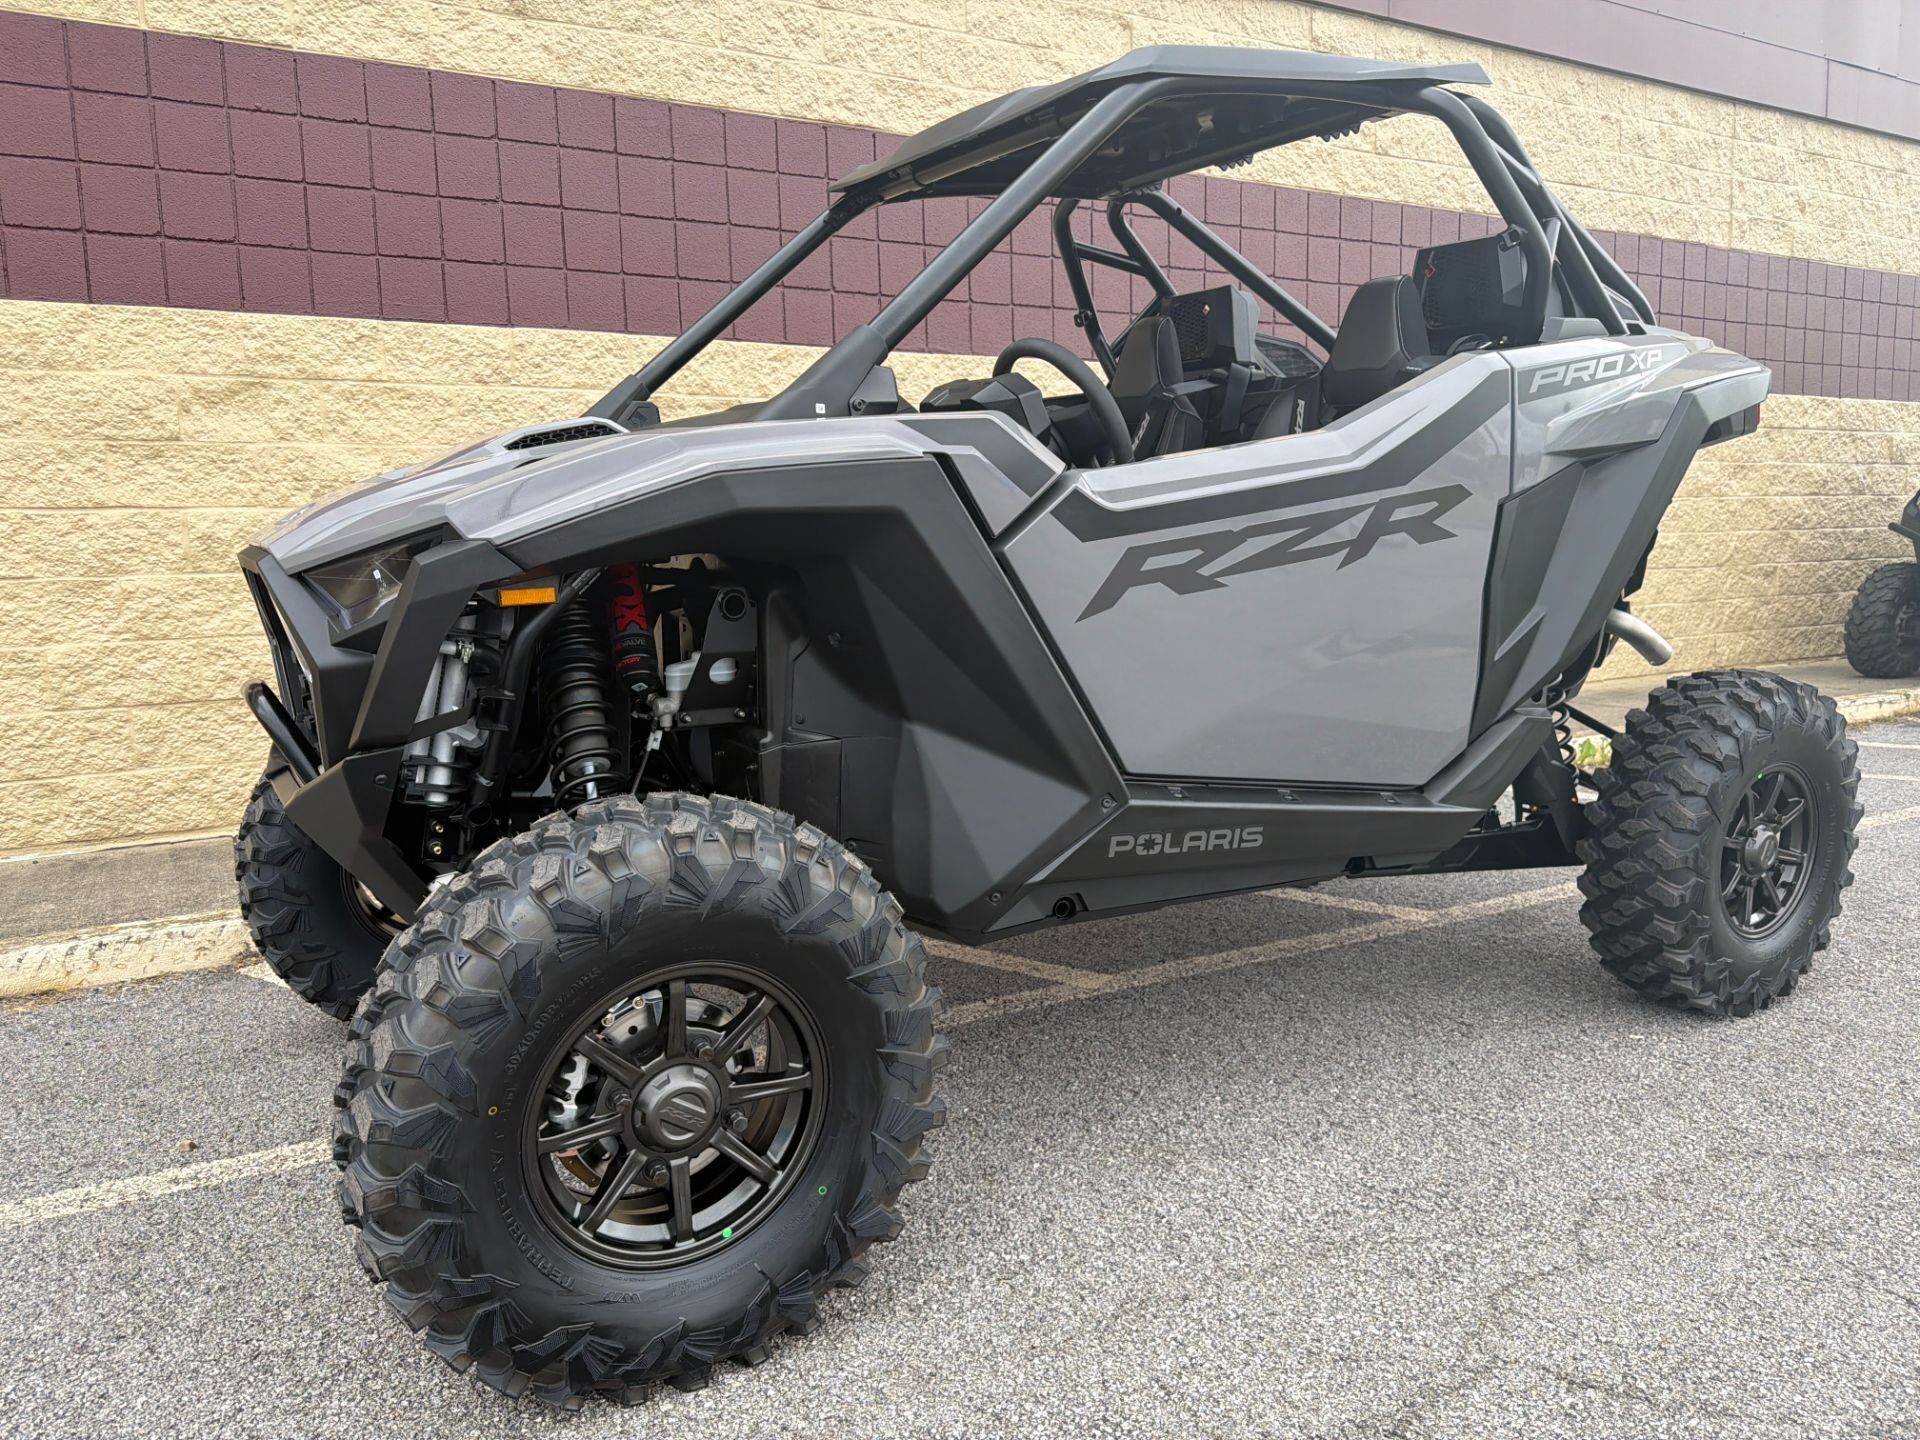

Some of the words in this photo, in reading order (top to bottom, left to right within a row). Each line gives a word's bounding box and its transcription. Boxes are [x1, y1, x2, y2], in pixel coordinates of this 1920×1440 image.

[1529, 354, 1626, 394] PRO
[1624, 349, 1662, 372] XP
[1074, 483, 1474, 624] RZR
[1107, 826, 1264, 858] POLARIS
